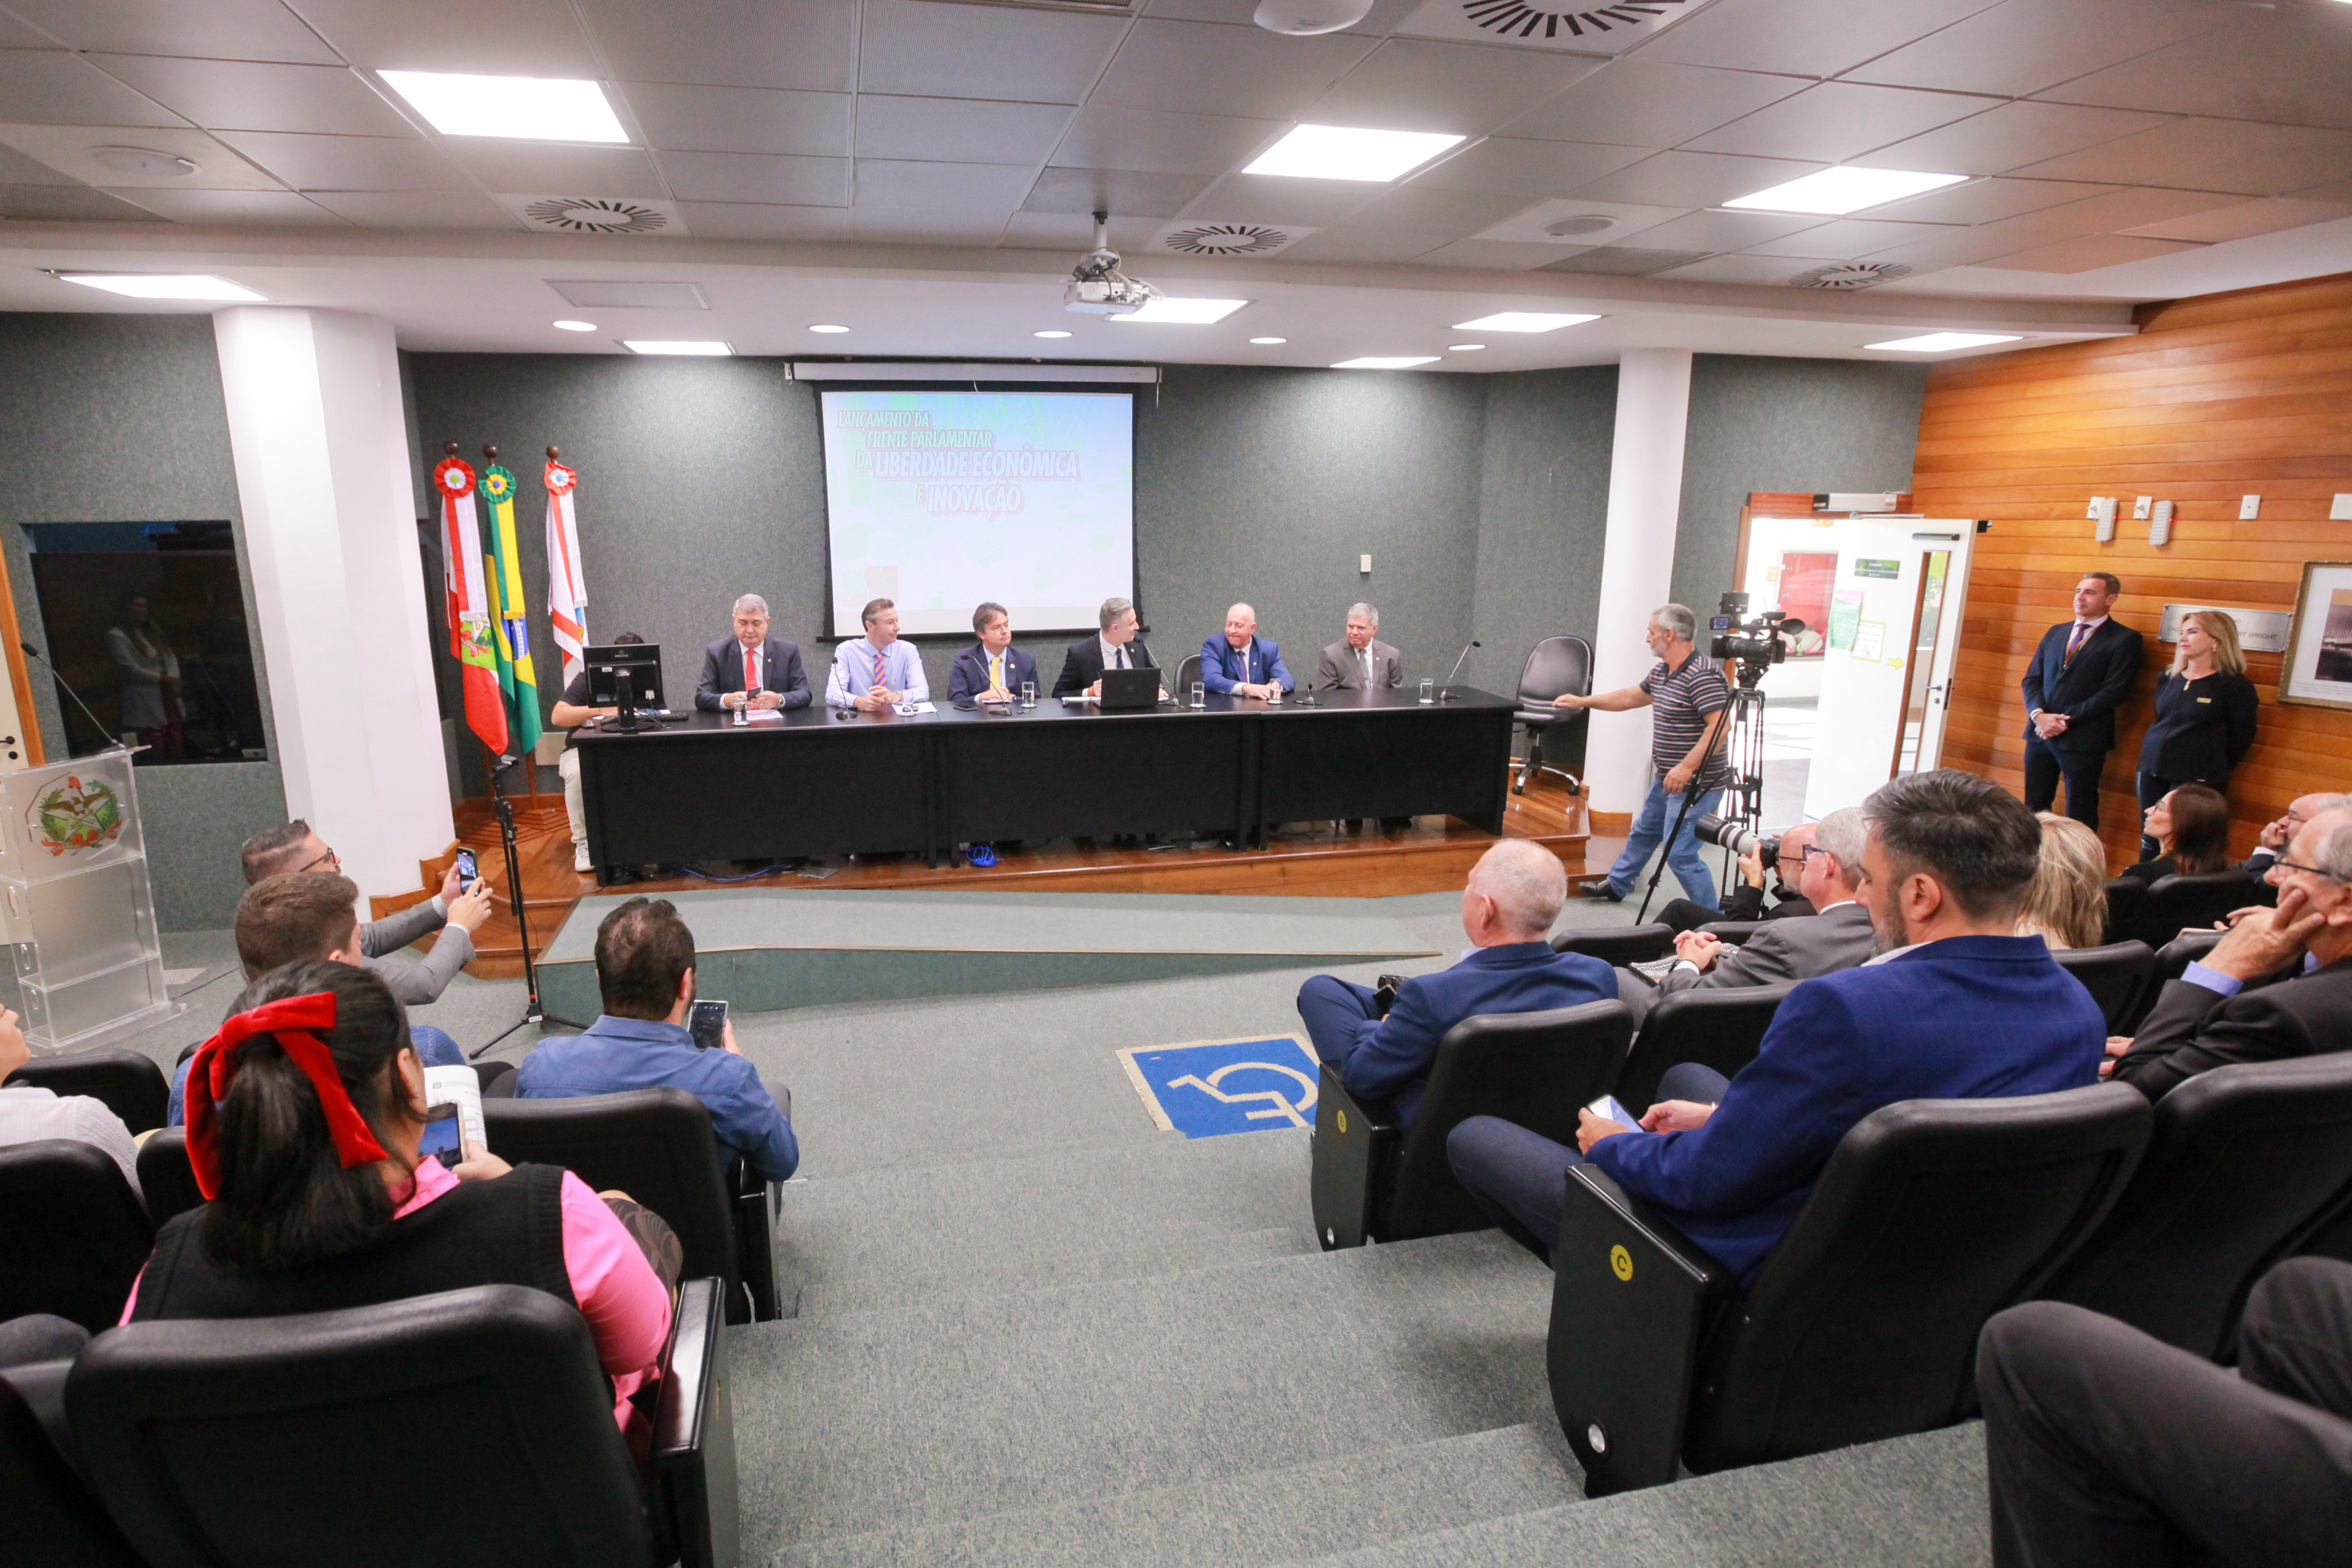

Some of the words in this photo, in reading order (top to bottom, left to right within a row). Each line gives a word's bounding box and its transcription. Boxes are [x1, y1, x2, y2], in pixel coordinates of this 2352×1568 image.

[838, 410, 913, 431] LANÇAMENTO
[913, 410, 931, 428] DA
[866, 430, 908, 448] FRENTE
[909, 430, 993, 448] PARLAMENTAR
[856, 451, 873, 469] DA
[874, 451, 970, 477] LIBERDADE
[971, 444, 1078, 477] ECONÔMICA
[916, 485, 924, 503] E
[927, 479, 1022, 518] INOVAÇÃO
[514, 619, 524, 656] ROGRESSO
[1617, 1254, 1627, 1272] C
